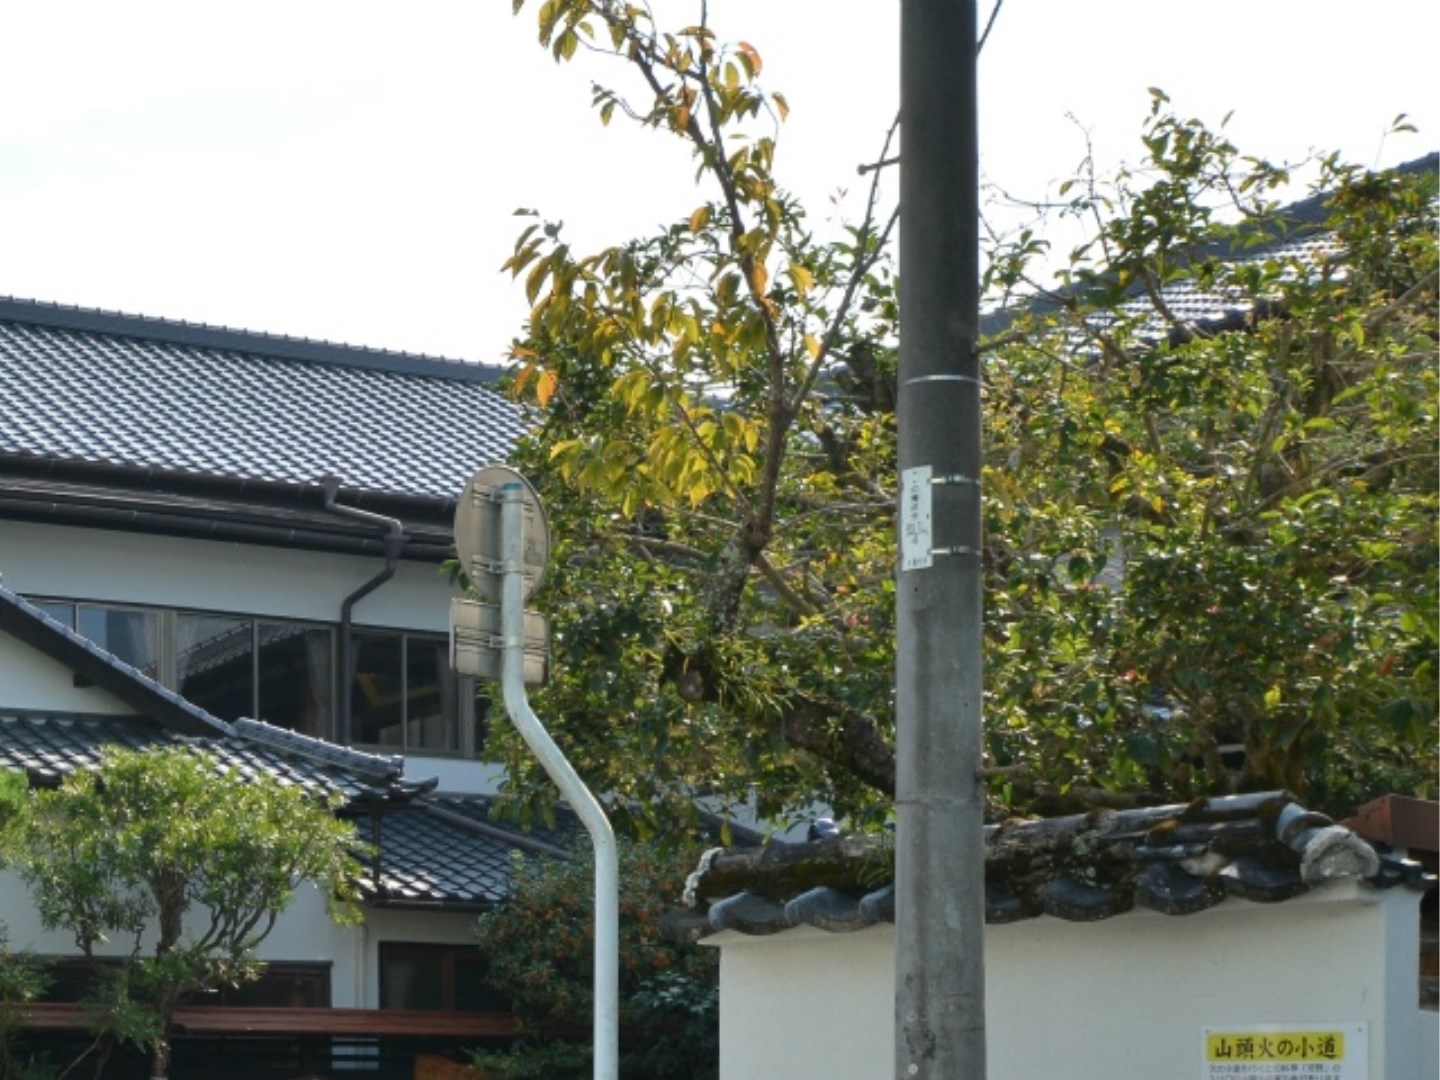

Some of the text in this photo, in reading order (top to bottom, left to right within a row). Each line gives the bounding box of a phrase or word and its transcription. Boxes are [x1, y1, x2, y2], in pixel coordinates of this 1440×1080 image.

[1214, 1035, 1338, 1059] 山頭火の小道
